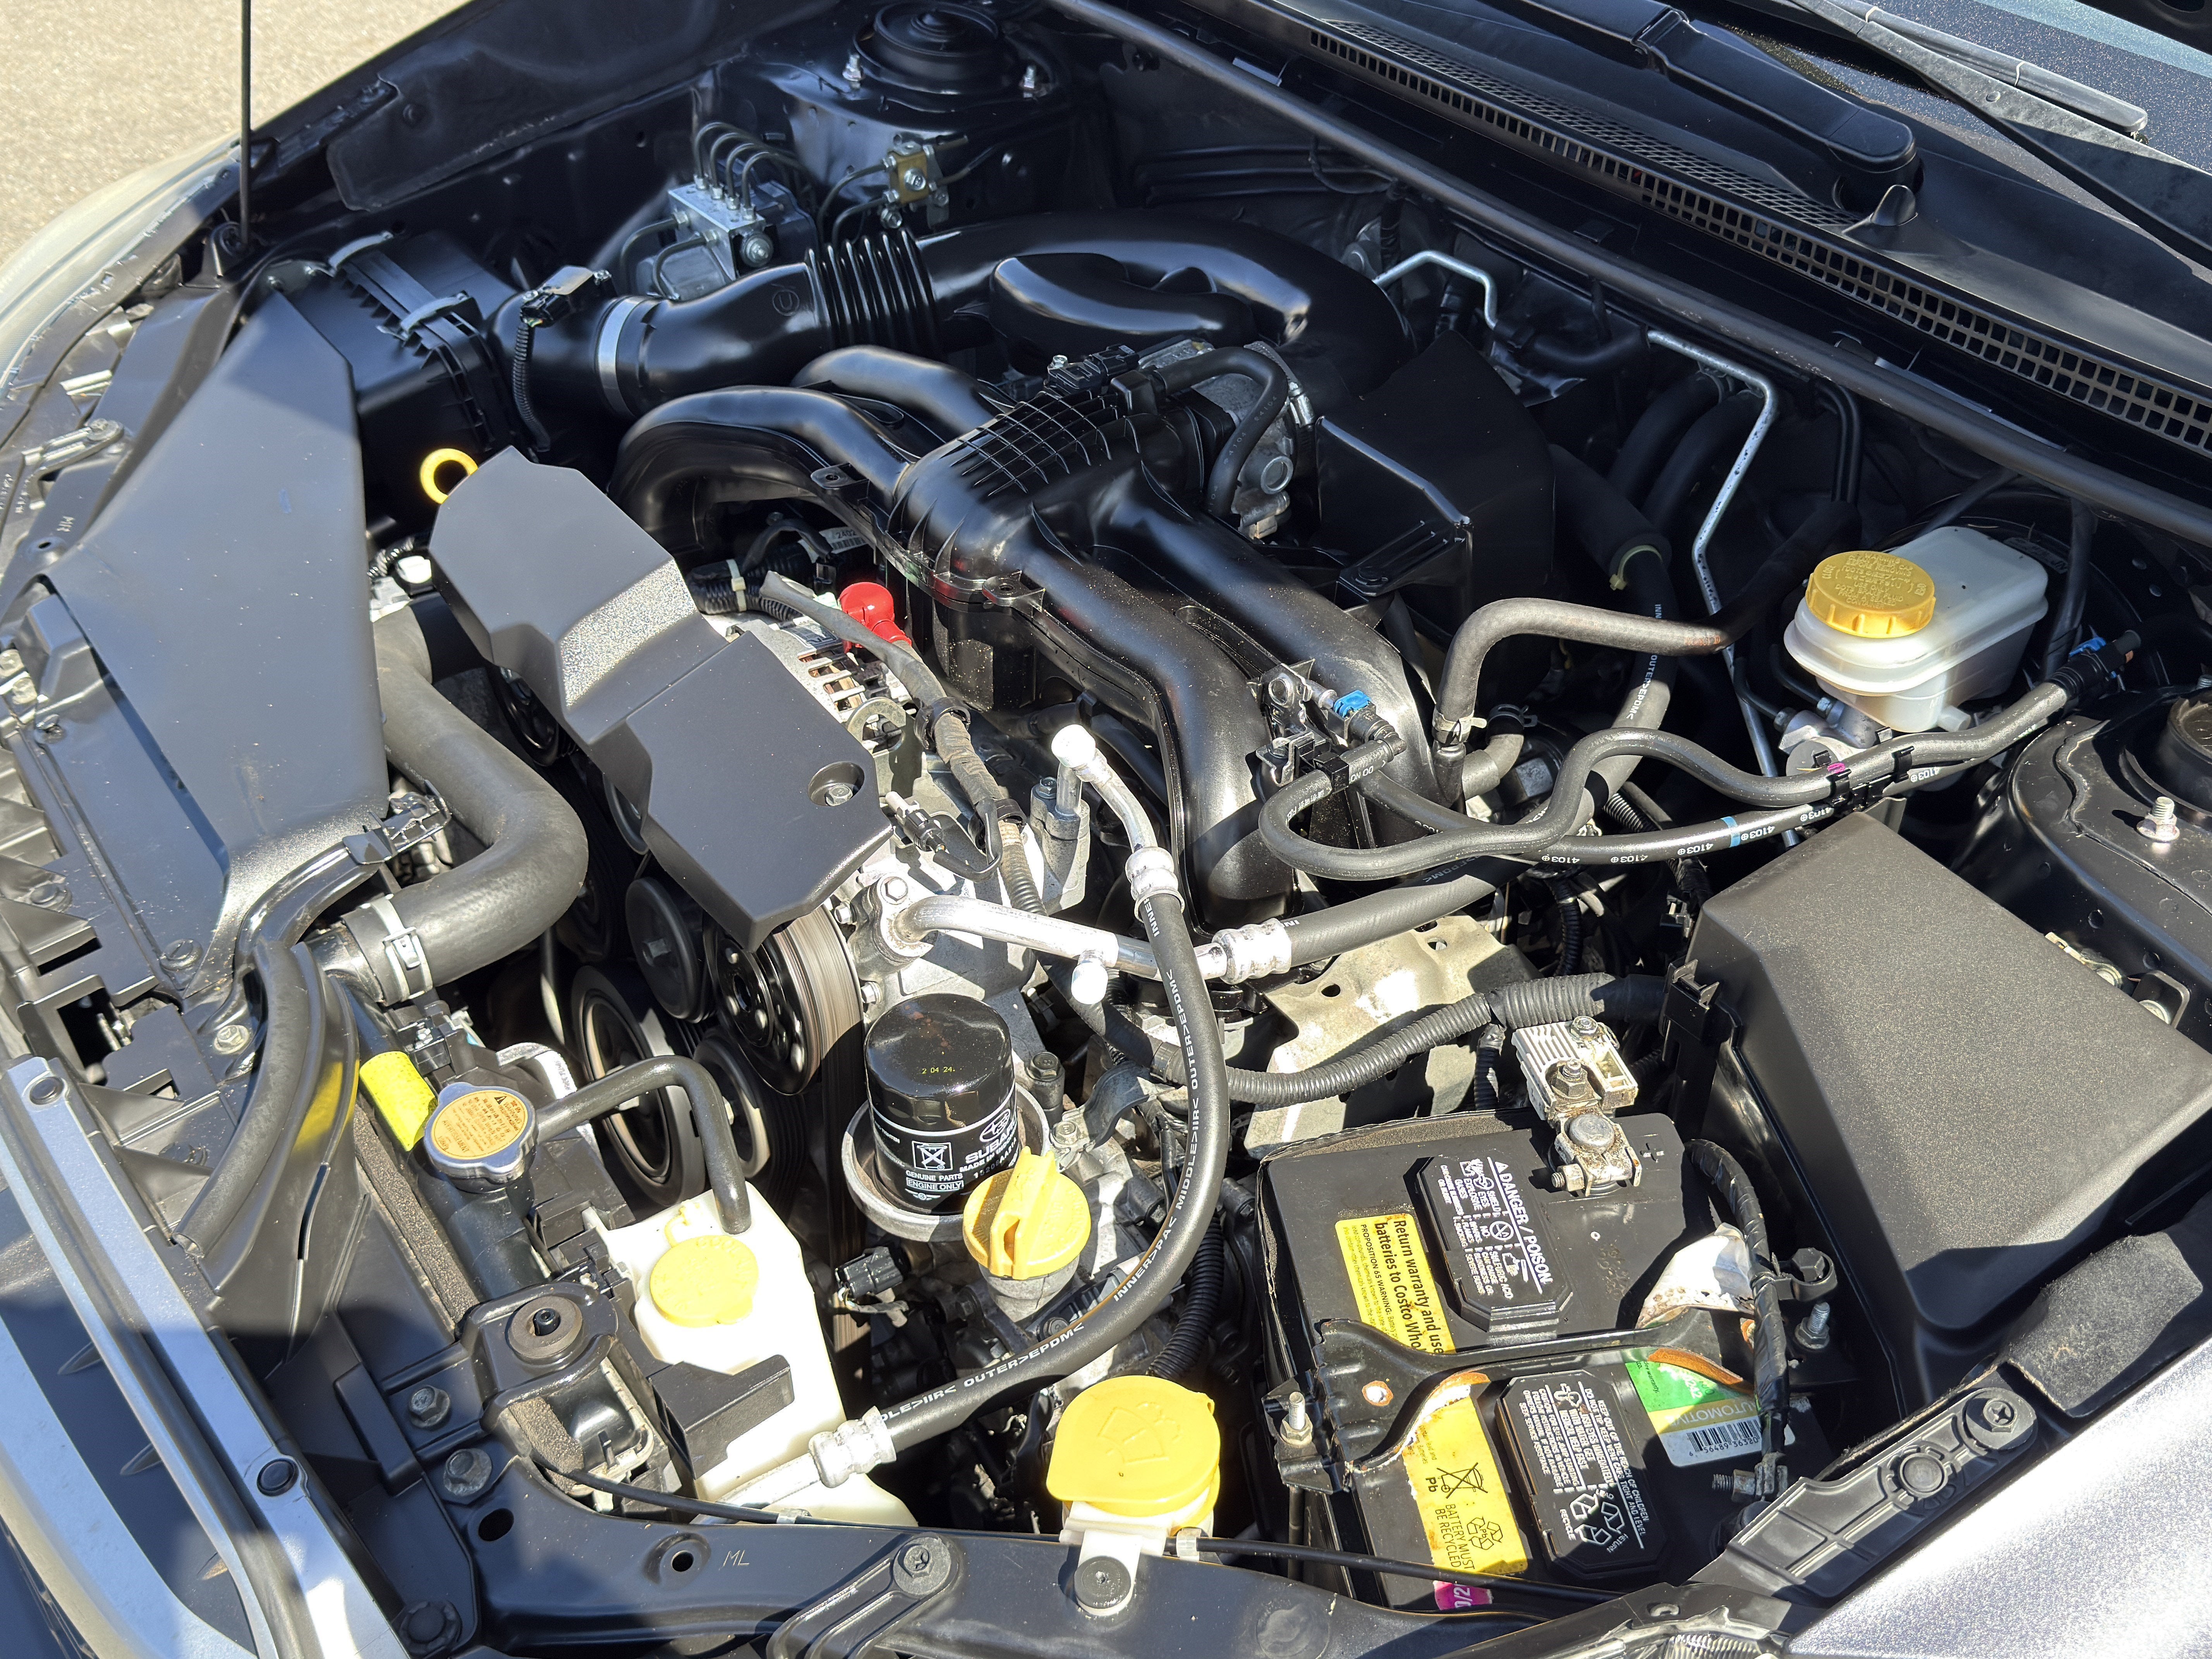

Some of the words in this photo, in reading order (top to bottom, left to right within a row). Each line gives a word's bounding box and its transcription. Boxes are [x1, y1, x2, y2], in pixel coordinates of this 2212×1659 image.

[1349, 771, 1362, 783] NO
[1748, 826, 1775, 841] 4103
[1686, 842, 1714, 855] 4103
[1551, 855, 1580, 864] 4103
[1620, 854, 1648, 864] 4103
[959, 1159, 985, 1172] MADE
[986, 1152, 995, 1162] IN
[905, 1169, 936, 1182] GENUINE
[939, 1172, 963, 1182] PARTS
[908, 1179, 938, 1190] ENGINE
[939, 1180, 962, 1190] ONLY
[1453, 1178, 1469, 1199] GASES
[1463, 1178, 1483, 1211] EXPLOSIVE
[1477, 1191, 1491, 1207] EYES
[1486, 1190, 1502, 1212] SHIELD
[1479, 1225, 1491, 1237] NO
[1498, 1173, 1531, 1224] DANGER
[1522, 1235, 1554, 1284] POISON
[1359, 1224, 1380, 1269] PROPOSITION
[1373, 1222, 1401, 1270] batteries
[1392, 1220, 1416, 1256] Return
[1464, 1253, 1479, 1275] SEVERE
[1480, 1251, 1492, 1265] CAN
[1373, 1270, 1382, 1278] 65
[1388, 1271, 1403, 1283] to
[1401, 1259, 1431, 1307] warranty
[1485, 1264, 1499, 1285] CAUSE
[1488, 1250, 1509, 1283] SULFURIC
[1500, 1283, 1514, 1299] ACID
[1376, 1280, 1393, 1315] WARNING:
[1392, 1285, 1416, 1320] Costco
[1420, 1309, 1441, 1331] and
[1428, 1334, 1444, 1354] use
[1645, 1370, 1660, 1394] warranty,
[1583, 1388, 1595, 1399] DO
[880, 1384, 957, 1422] DLE>IIR<
[1518, 1402, 1530, 1417] SEEK
[1588, 1399, 1600, 1413] NOT
[1596, 1400, 1610, 1416] KEEP
[1547, 1414, 1558, 1426] FOR
[1666, 1401, 1756, 1427] UTOMOTIV
[1522, 1390, 1538, 1414] OWNERS
[1542, 1445, 1553, 1458] NOT
[1523, 1417, 1539, 1441] SERVICE
[1558, 1410, 1577, 1436] MEDICAL
[1568, 1436, 1583, 1453] HELP
[1602, 1417, 1615, 1431] OUT
[1530, 1391, 1546, 1414] FOLLOW
[1539, 1414, 1560, 1453] INSTRUCTIONS
[1556, 1461, 1572, 1485] VEHICLE
[1551, 1426, 1564, 1441] SAFE
[1568, 1408, 1582, 1425] WITH
[1582, 1448, 1596, 1462] GET
[1585, 1427, 1600, 1444] EYES
[1599, 1427, 1612, 1444] KEEP
[1608, 1431, 1620, 1441] OF
[1557, 1441, 1570, 1457] JUMP
[1605, 1444, 1619, 1461] VENT
[1613, 1443, 1625, 1456] THE
[1704, 1443, 1729, 1454] 56489
[1733, 1437, 1758, 1448] 36320
[1591, 1444, 1614, 1483] IMMEDIATELY
[1612, 1462, 1625, 1478] CAPS
[1618, 1456, 1633, 1477] REACH
[1425, 1477, 1439, 1492] Pb
[1619, 1481, 1633, 1499] TIGHT
[1627, 1479, 1637, 1488] OF
[1434, 1508, 1447, 1520] BE
[1627, 1501, 1639, 1515] AND
[1631, 1489, 1650, 1521] CHILDREN
[1479, 1528, 1488, 1538] Pb
[1560, 1509, 1577, 1540] RECYCLE
[1633, 1516, 1647, 1535] LEVEL
[1437, 1522, 1463, 1568] RECYCLED
[1445, 1504, 1466, 1541] BATTERY
[1456, 1544, 1475, 1570] MUST
[1606, 1533, 1629, 1554] RETURN
[1453, 1584, 1473, 1608] 0/2
